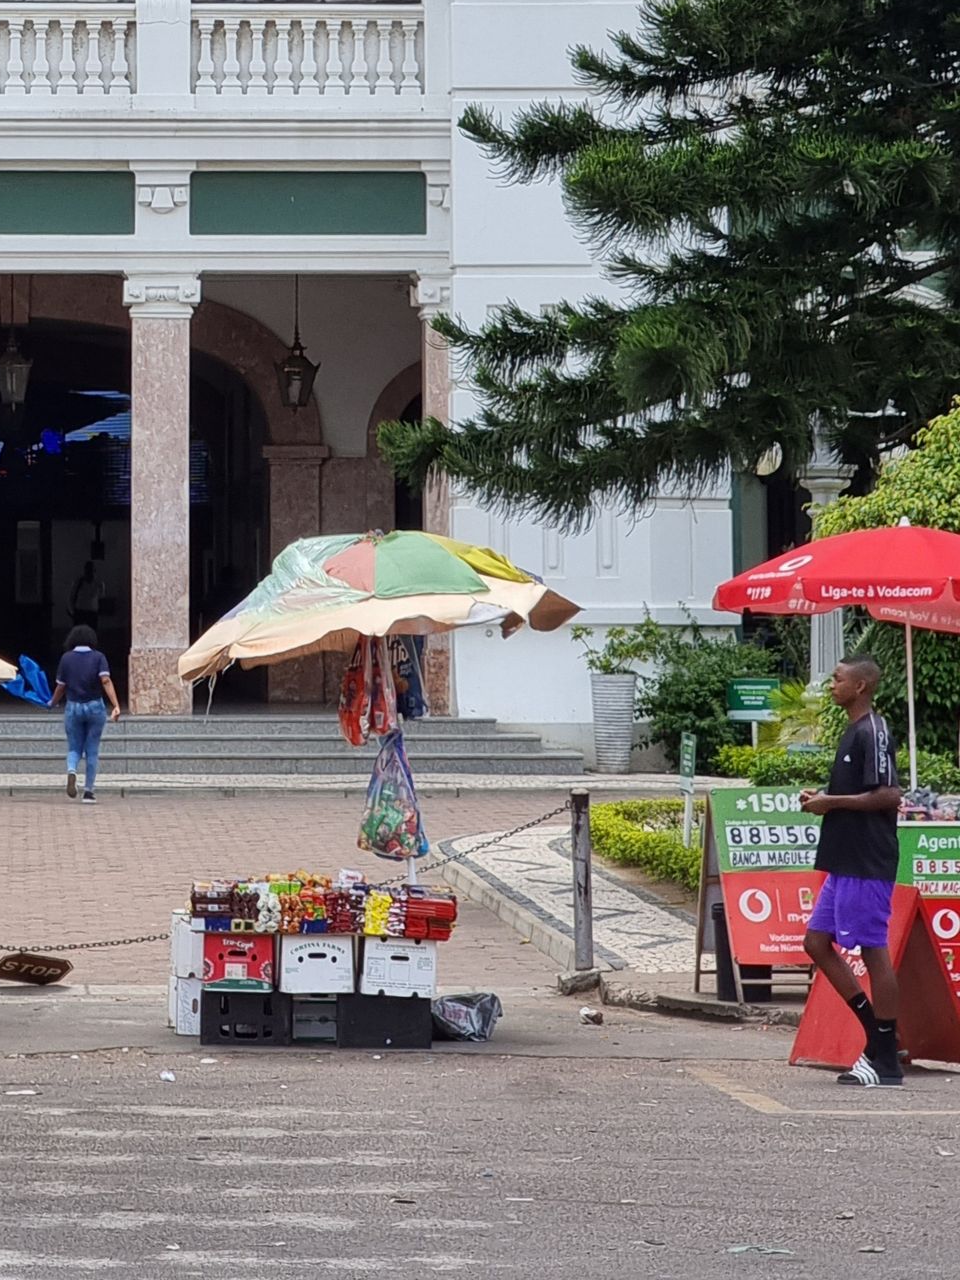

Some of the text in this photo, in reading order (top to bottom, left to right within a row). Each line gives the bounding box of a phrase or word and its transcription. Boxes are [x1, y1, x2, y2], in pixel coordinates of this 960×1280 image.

[821, 585, 933, 600] Liga-te à Vodacom
[917, 834, 960, 853] Agen
[732, 851, 761, 866] BANCA
[1, 961, 62, 977] STOP
